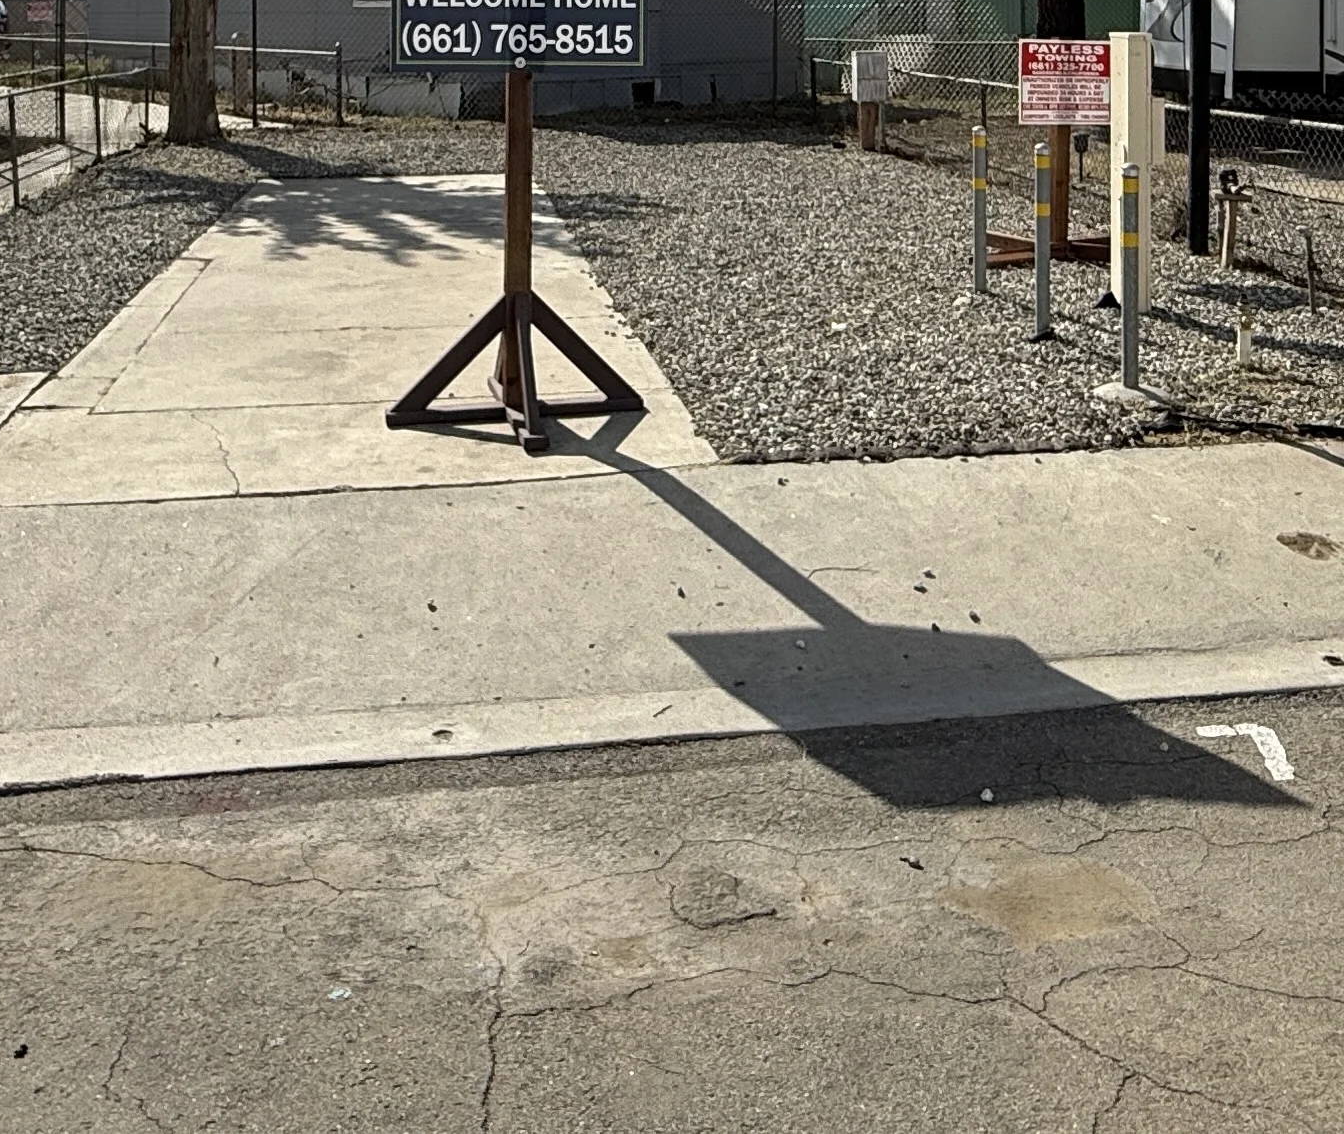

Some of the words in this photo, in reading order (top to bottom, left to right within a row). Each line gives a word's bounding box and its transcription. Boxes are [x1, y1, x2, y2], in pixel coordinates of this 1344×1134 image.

[401, 20, 482, 57] (661)
[490, 23, 634, 55] 765-8515
[1028, 44, 1105, 55] PAYLESS
[1035, 53, 1097, 62] TOWING
[1028, 61, 1054, 70] (661)
